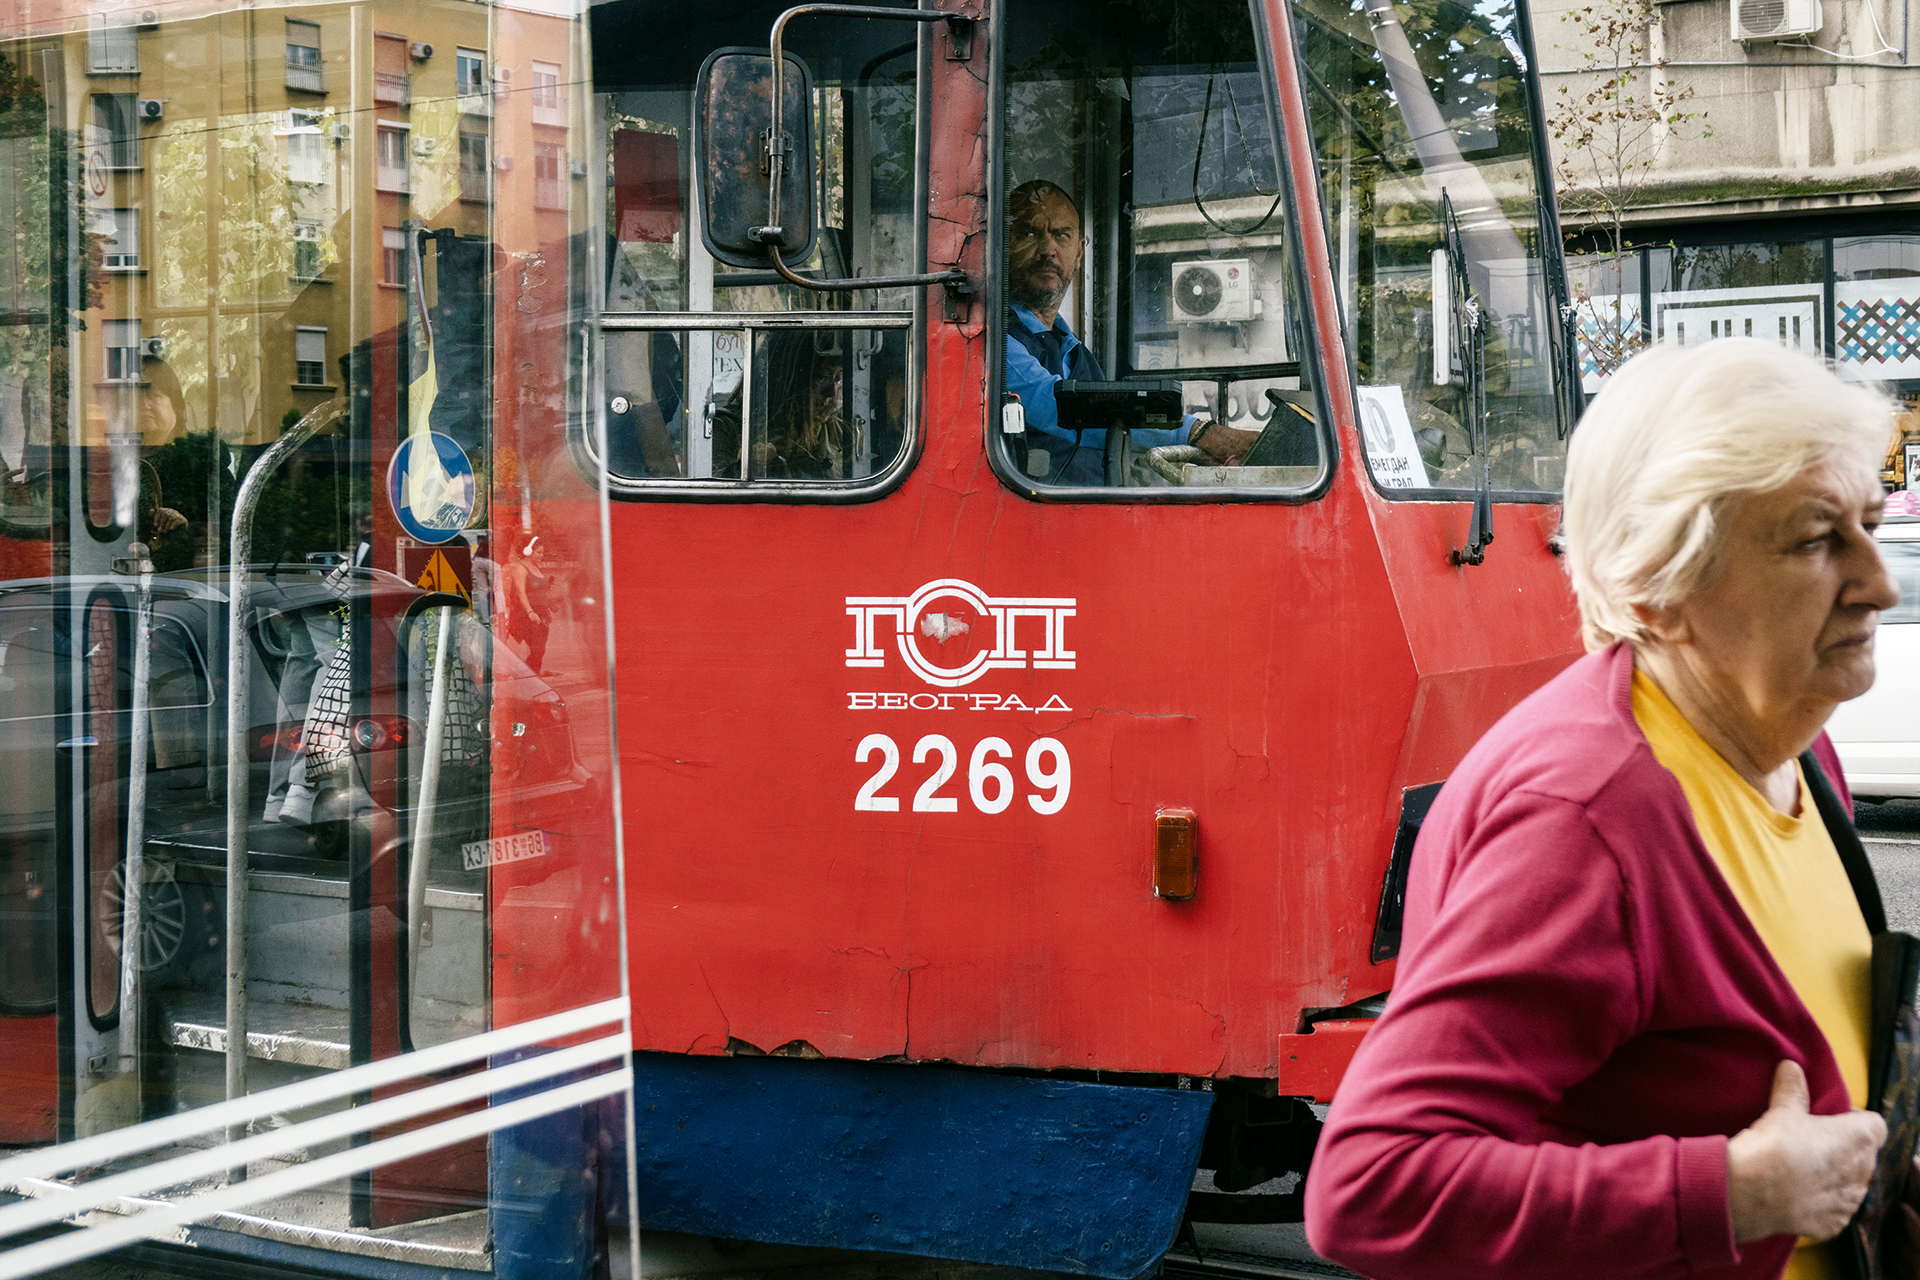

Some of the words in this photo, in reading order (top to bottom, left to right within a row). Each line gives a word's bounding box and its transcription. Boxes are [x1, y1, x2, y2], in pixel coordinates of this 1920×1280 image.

[1358, 391, 1396, 454] 0
[845, 578, 1077, 687] ГСП
[847, 692, 1073, 714] БЕОГРАД
[854, 733, 1072, 815] 2269
